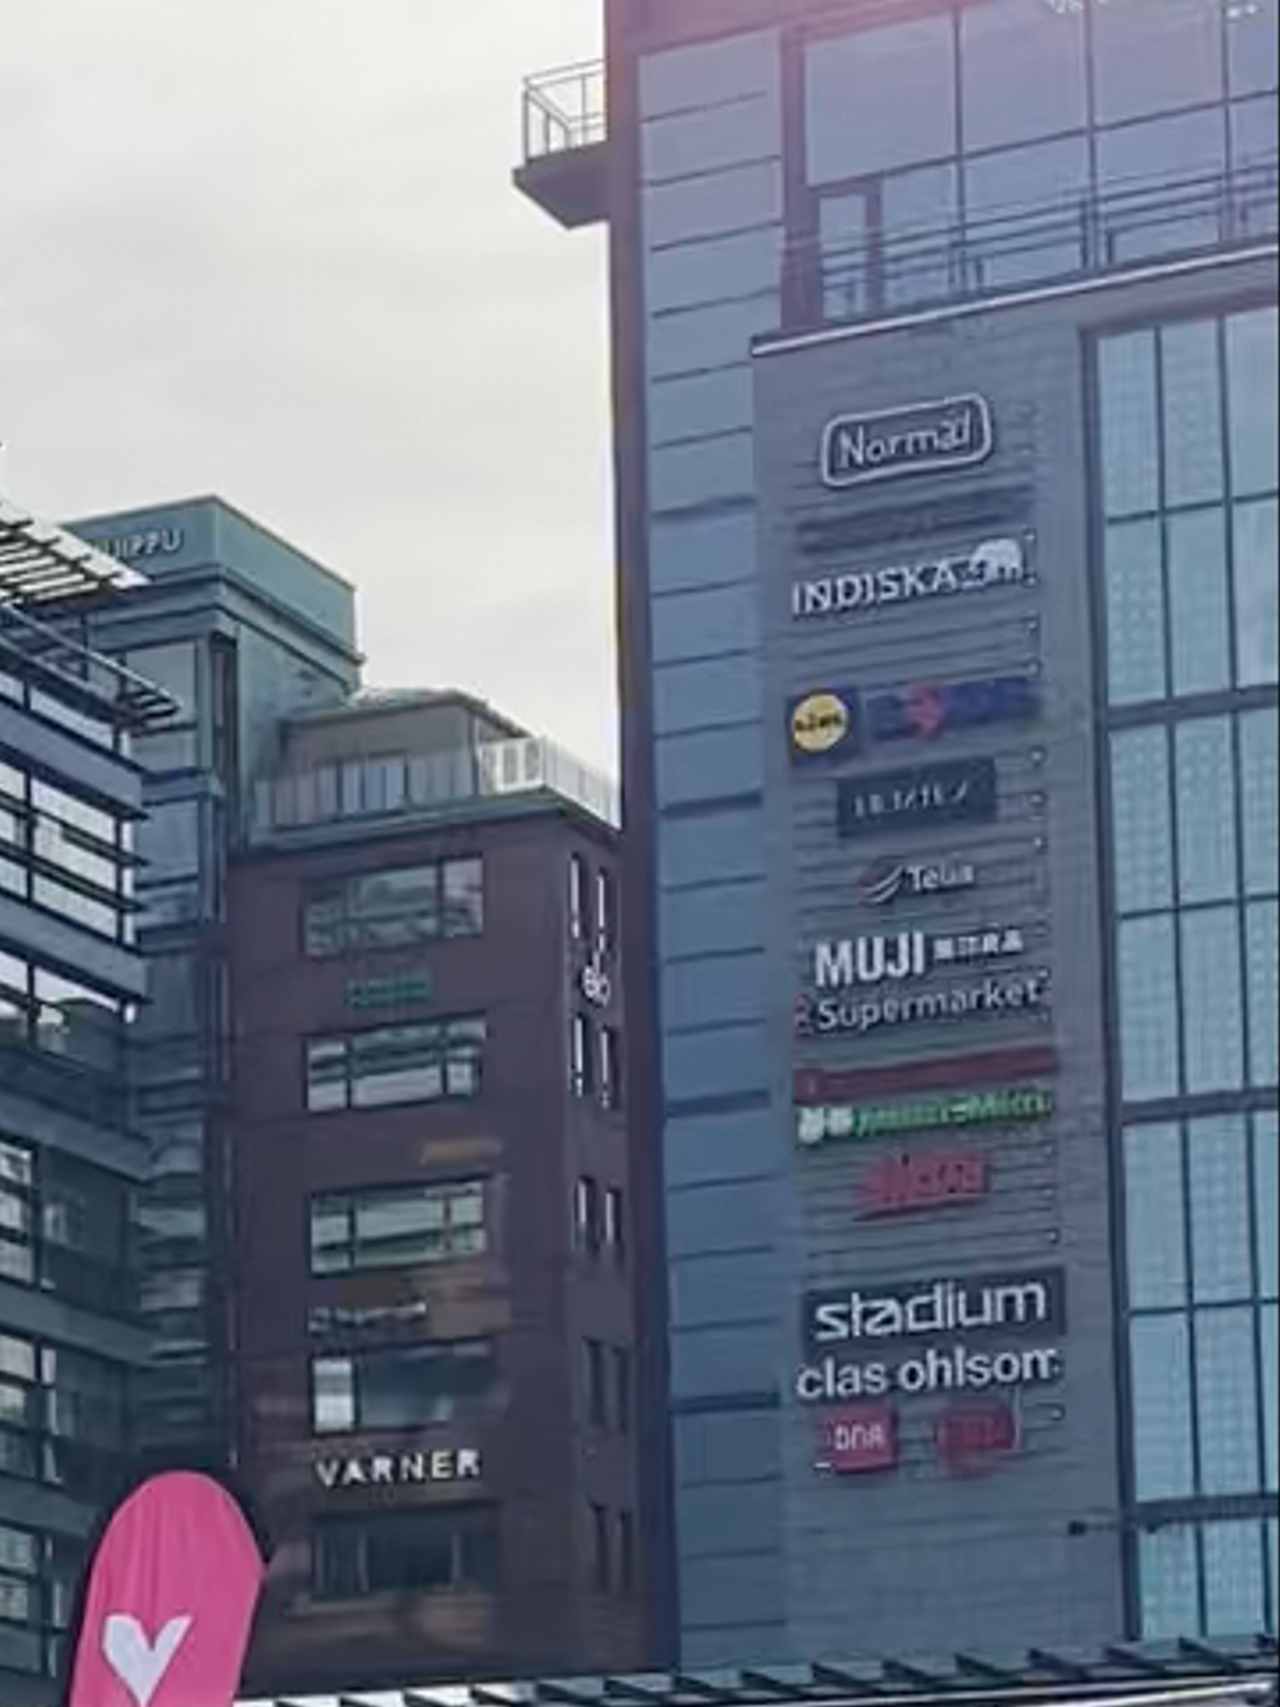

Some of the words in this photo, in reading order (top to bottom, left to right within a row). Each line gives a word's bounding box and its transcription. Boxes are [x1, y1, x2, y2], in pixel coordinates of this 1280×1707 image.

[840, 406, 972, 470] Normal
[792, 559, 958, 615] INDISKA
[815, 931, 925, 988] MUJI
[817, 977, 1044, 1032] Supermarket
[814, 1281, 1047, 1341] stadium
[796, 1355, 888, 1399] clas
[898, 1345, 1057, 1392] ohlson
[315, 1448, 481, 1488] VARNER
